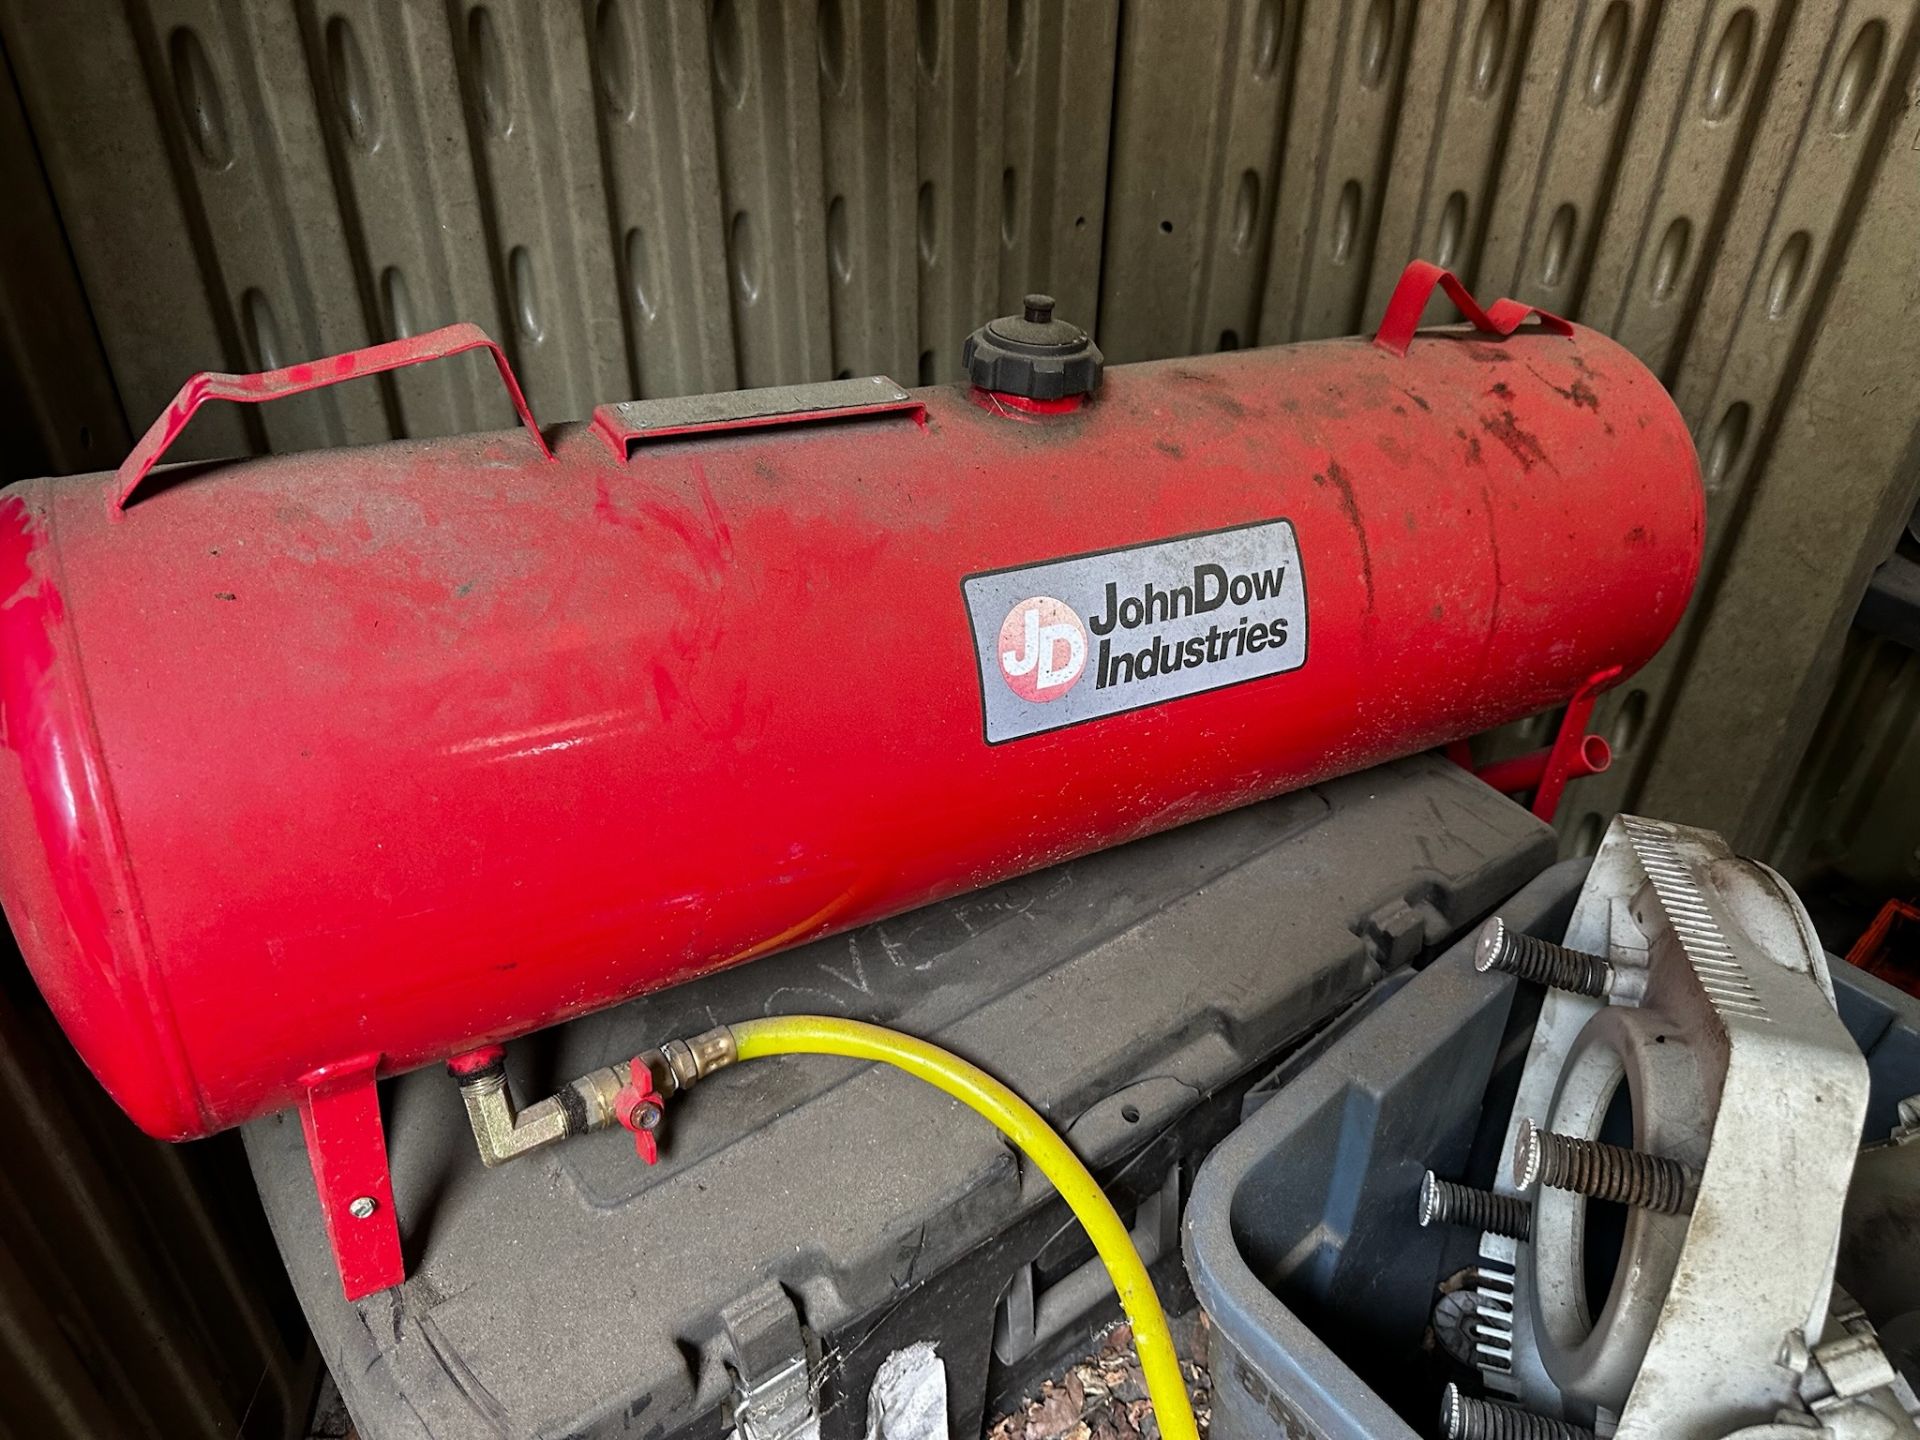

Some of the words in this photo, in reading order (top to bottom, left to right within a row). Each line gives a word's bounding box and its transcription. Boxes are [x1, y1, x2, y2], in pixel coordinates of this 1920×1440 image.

[1089, 563, 1286, 636] JohnDow
[1002, 608, 1080, 690] JD
[1096, 616, 1289, 690] Industries
